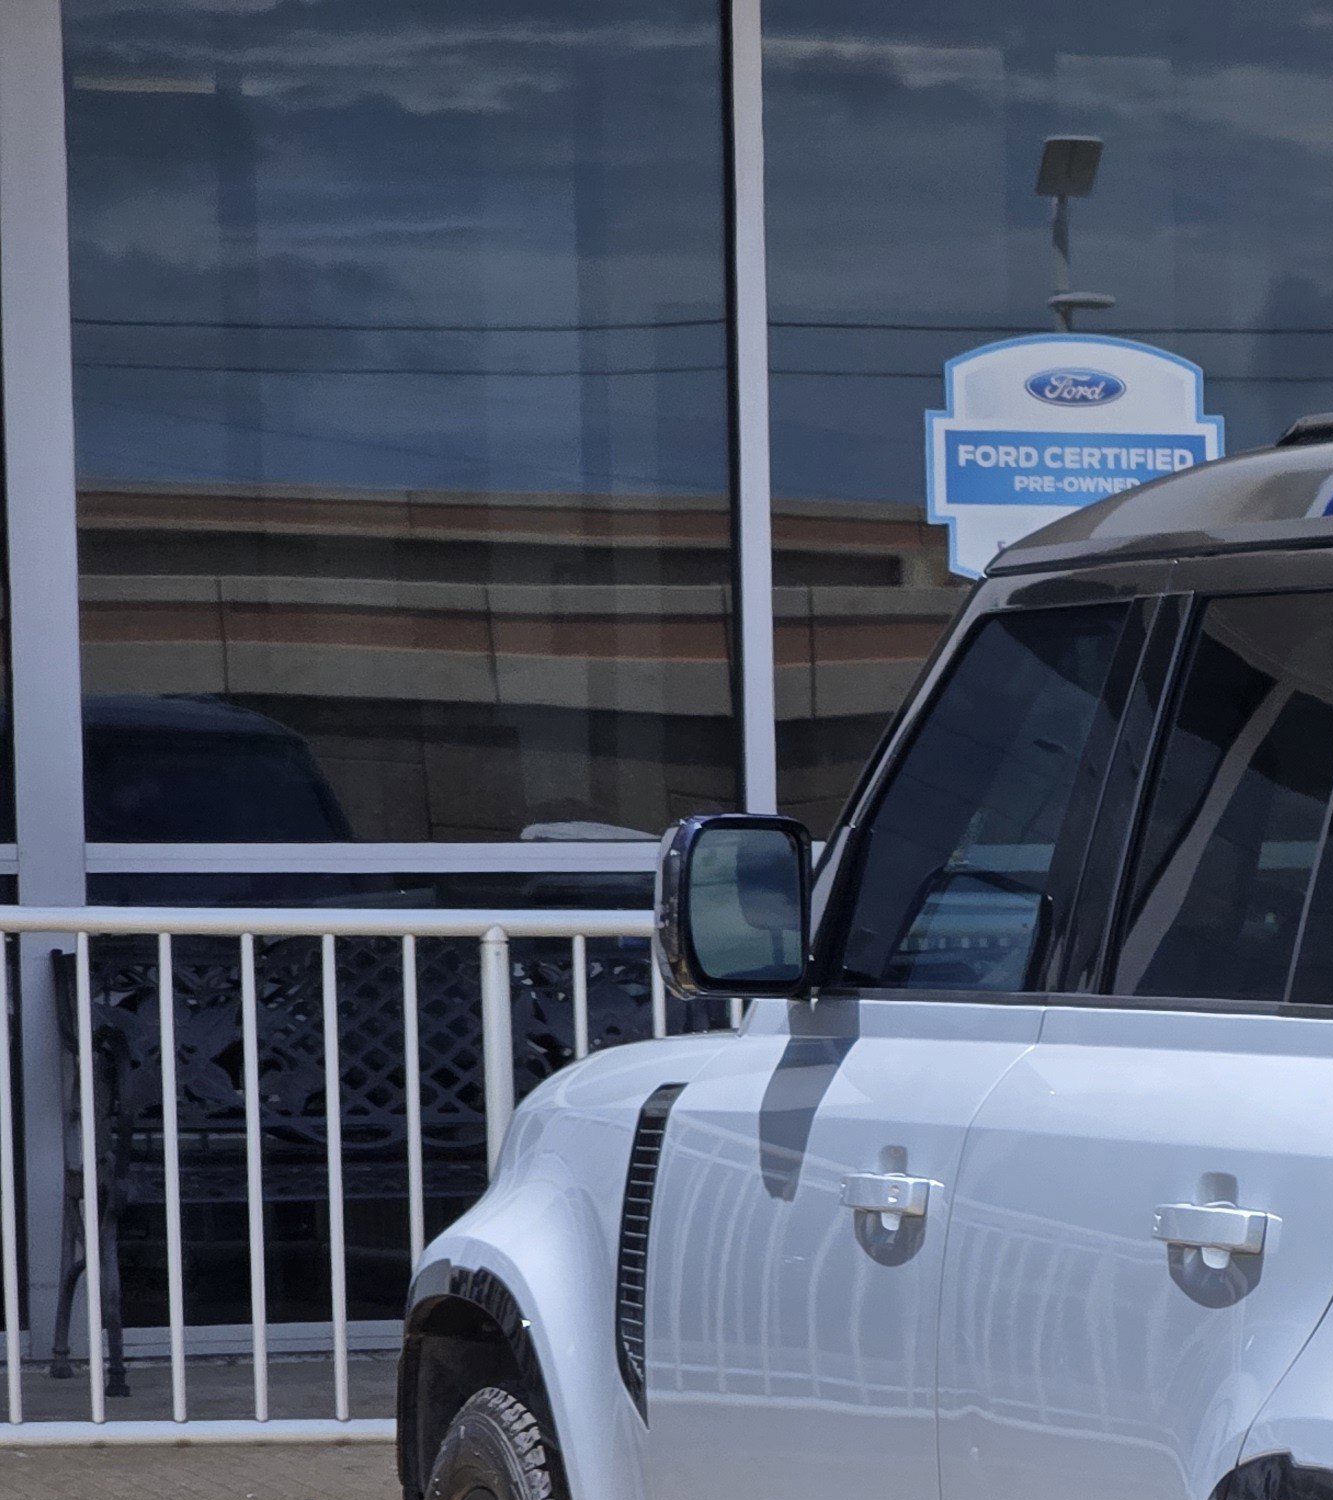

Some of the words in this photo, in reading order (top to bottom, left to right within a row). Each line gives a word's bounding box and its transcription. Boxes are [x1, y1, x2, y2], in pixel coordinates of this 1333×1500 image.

[1044, 374, 1104, 400] Ford
[957, 444, 1038, 468] FORD
[1044, 447, 1193, 471] CERTIFIED
